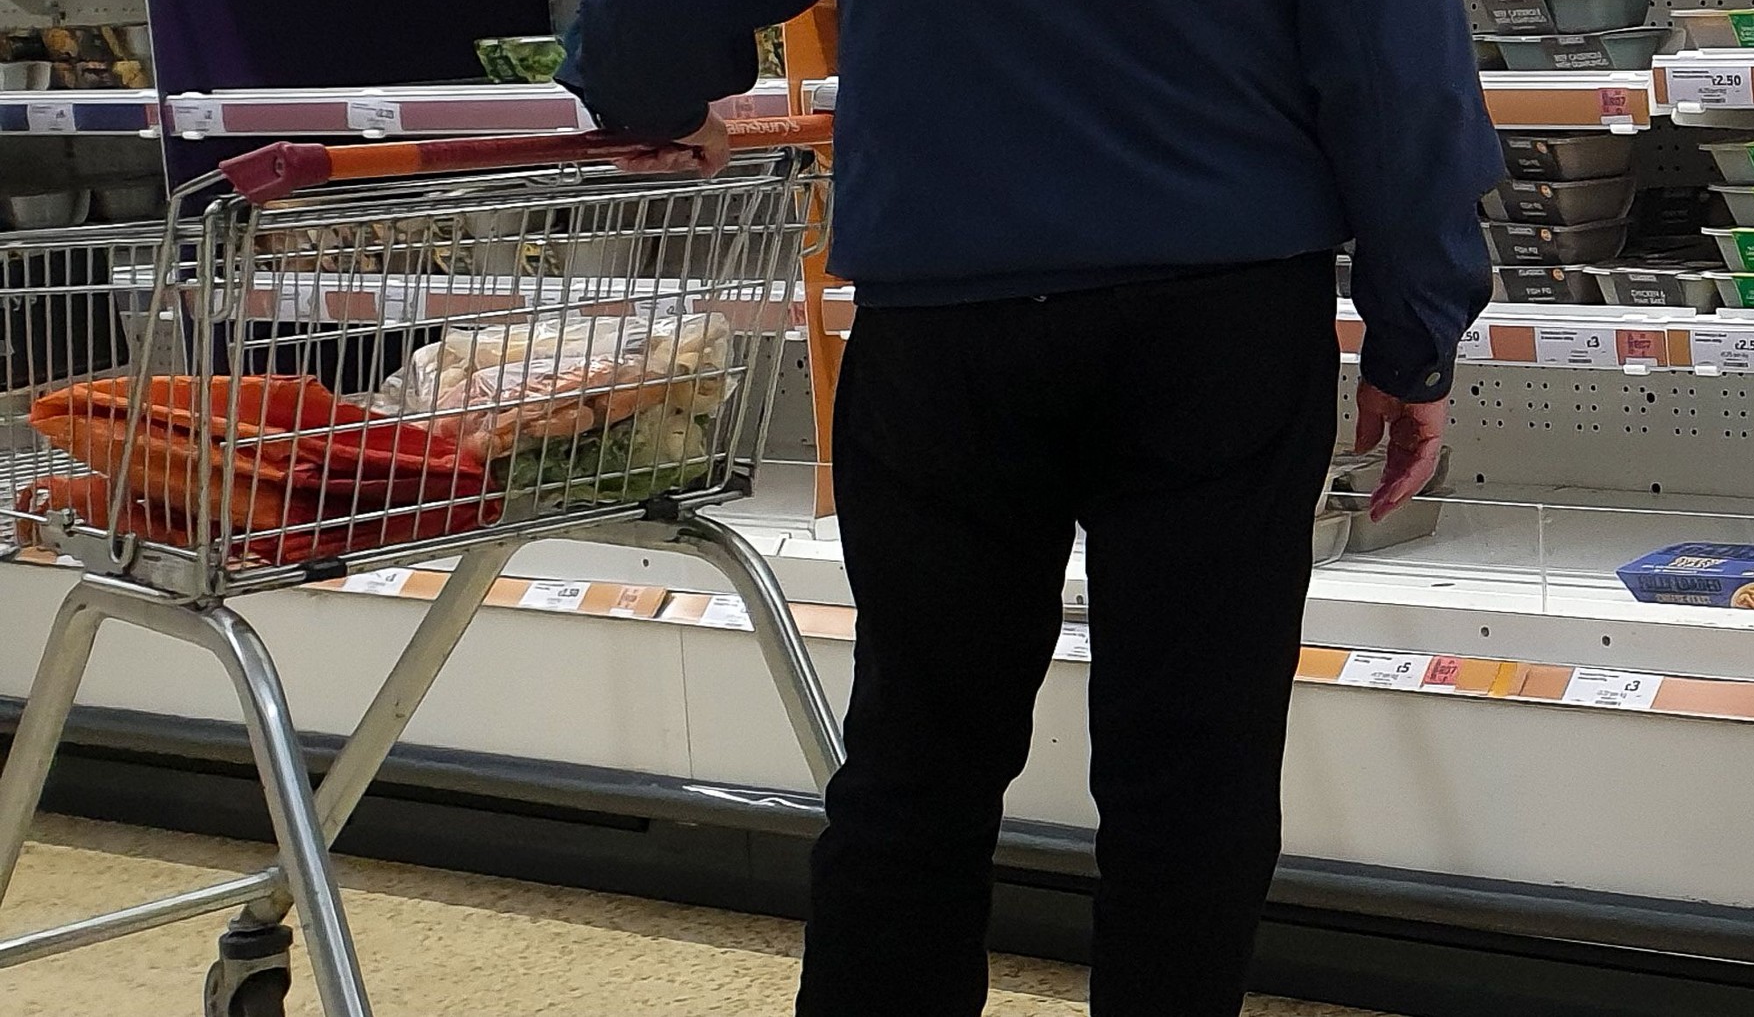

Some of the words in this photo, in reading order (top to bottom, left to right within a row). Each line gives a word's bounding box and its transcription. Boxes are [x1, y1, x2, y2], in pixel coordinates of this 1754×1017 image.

[1712, 75, 1742, 86] £2.50
[1587, 336, 1600, 348] £3
[1624, 680, 1641, 692] £3
